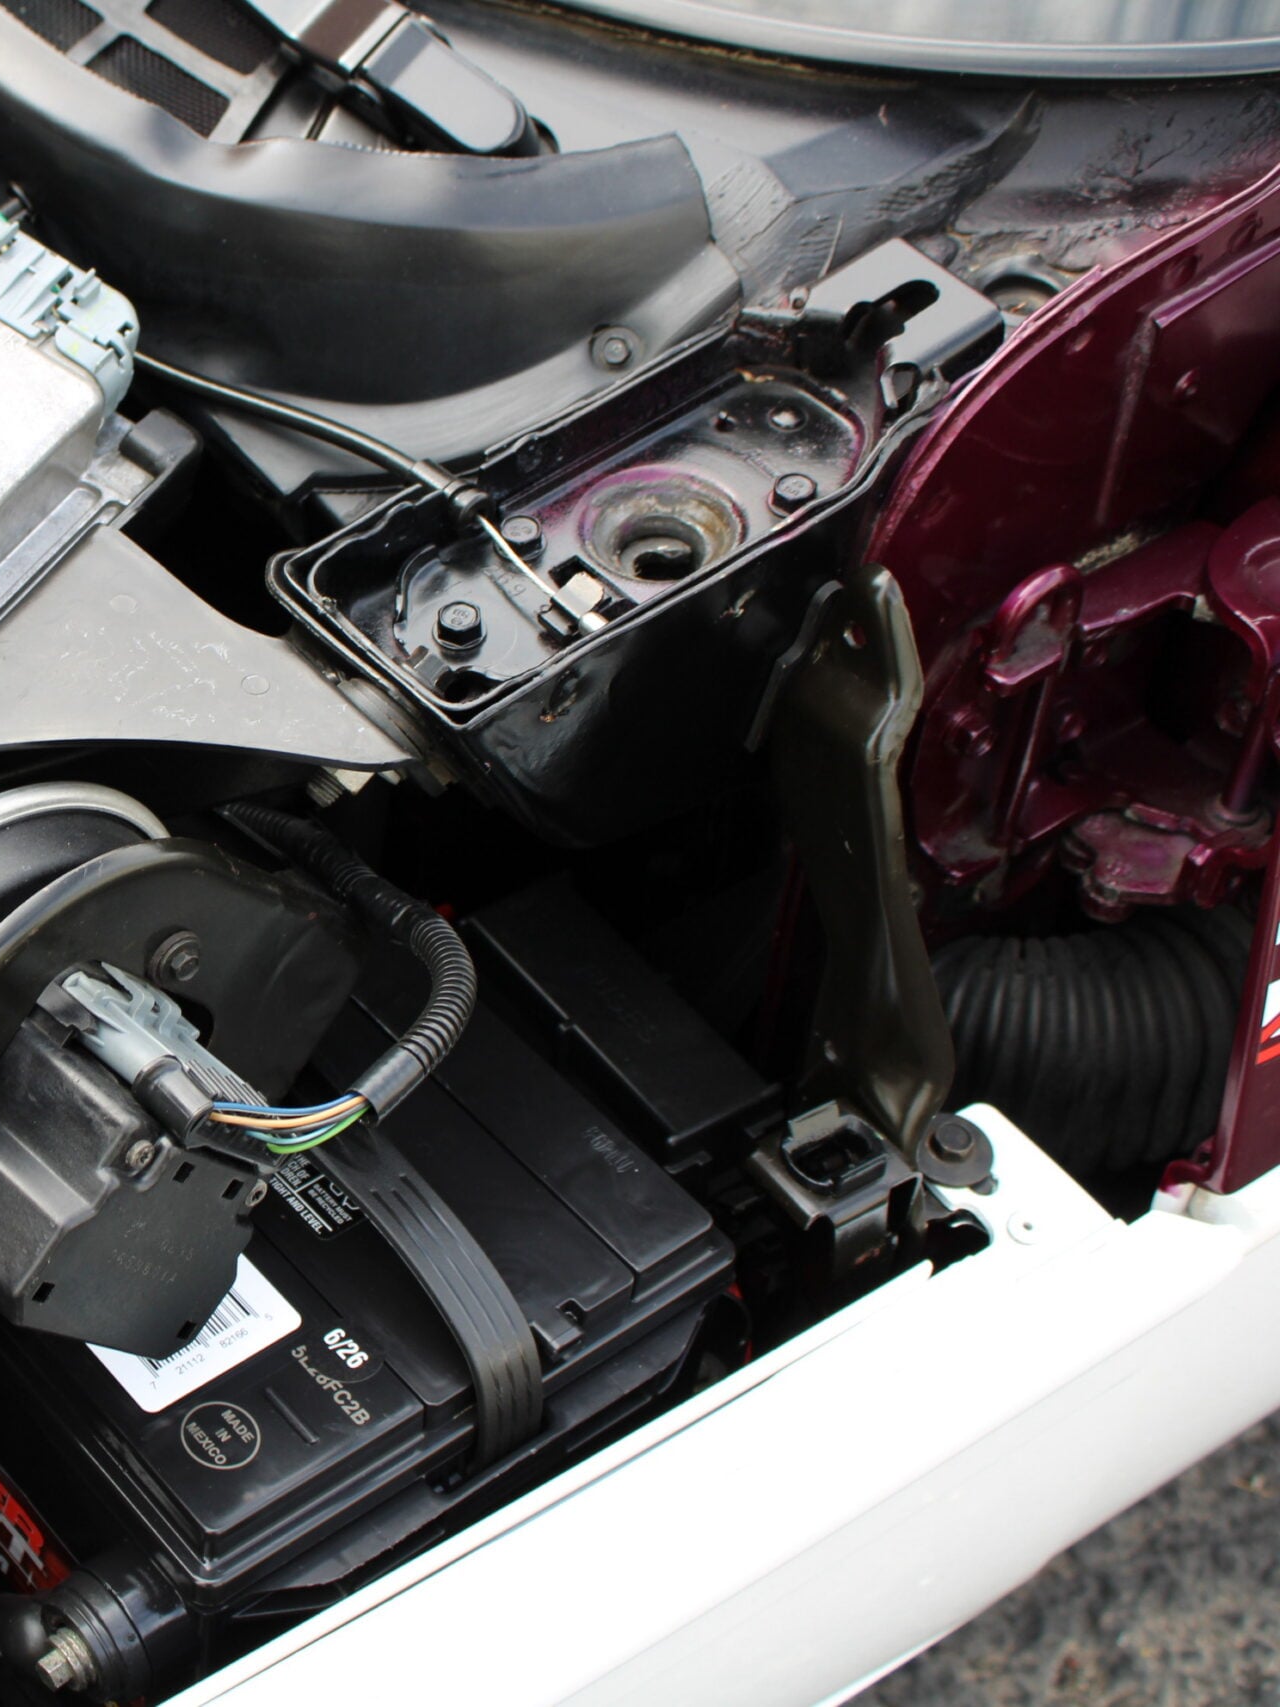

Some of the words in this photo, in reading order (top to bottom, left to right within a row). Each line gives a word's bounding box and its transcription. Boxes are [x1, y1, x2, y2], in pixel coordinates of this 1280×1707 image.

[280, 1167, 302, 1189] DREN.
[297, 1169, 311, 1179] OF
[269, 1177, 291, 1198] TIGHT
[286, 1196, 305, 1213] AND
[300, 1209, 323, 1235] LEVEL.
[313, 1183, 338, 1207] BATTERY
[335, 1204, 353, 1221] MUST
[315, 1196, 345, 1225] RECYCLED
[322, 1328, 370, 1369] 6/26
[175, 1354, 206, 1376] 21112
[215, 1427, 232, 1444] IN
[221, 1408, 256, 1444] MADE
[185, 1422, 227, 1466] MEXICO
